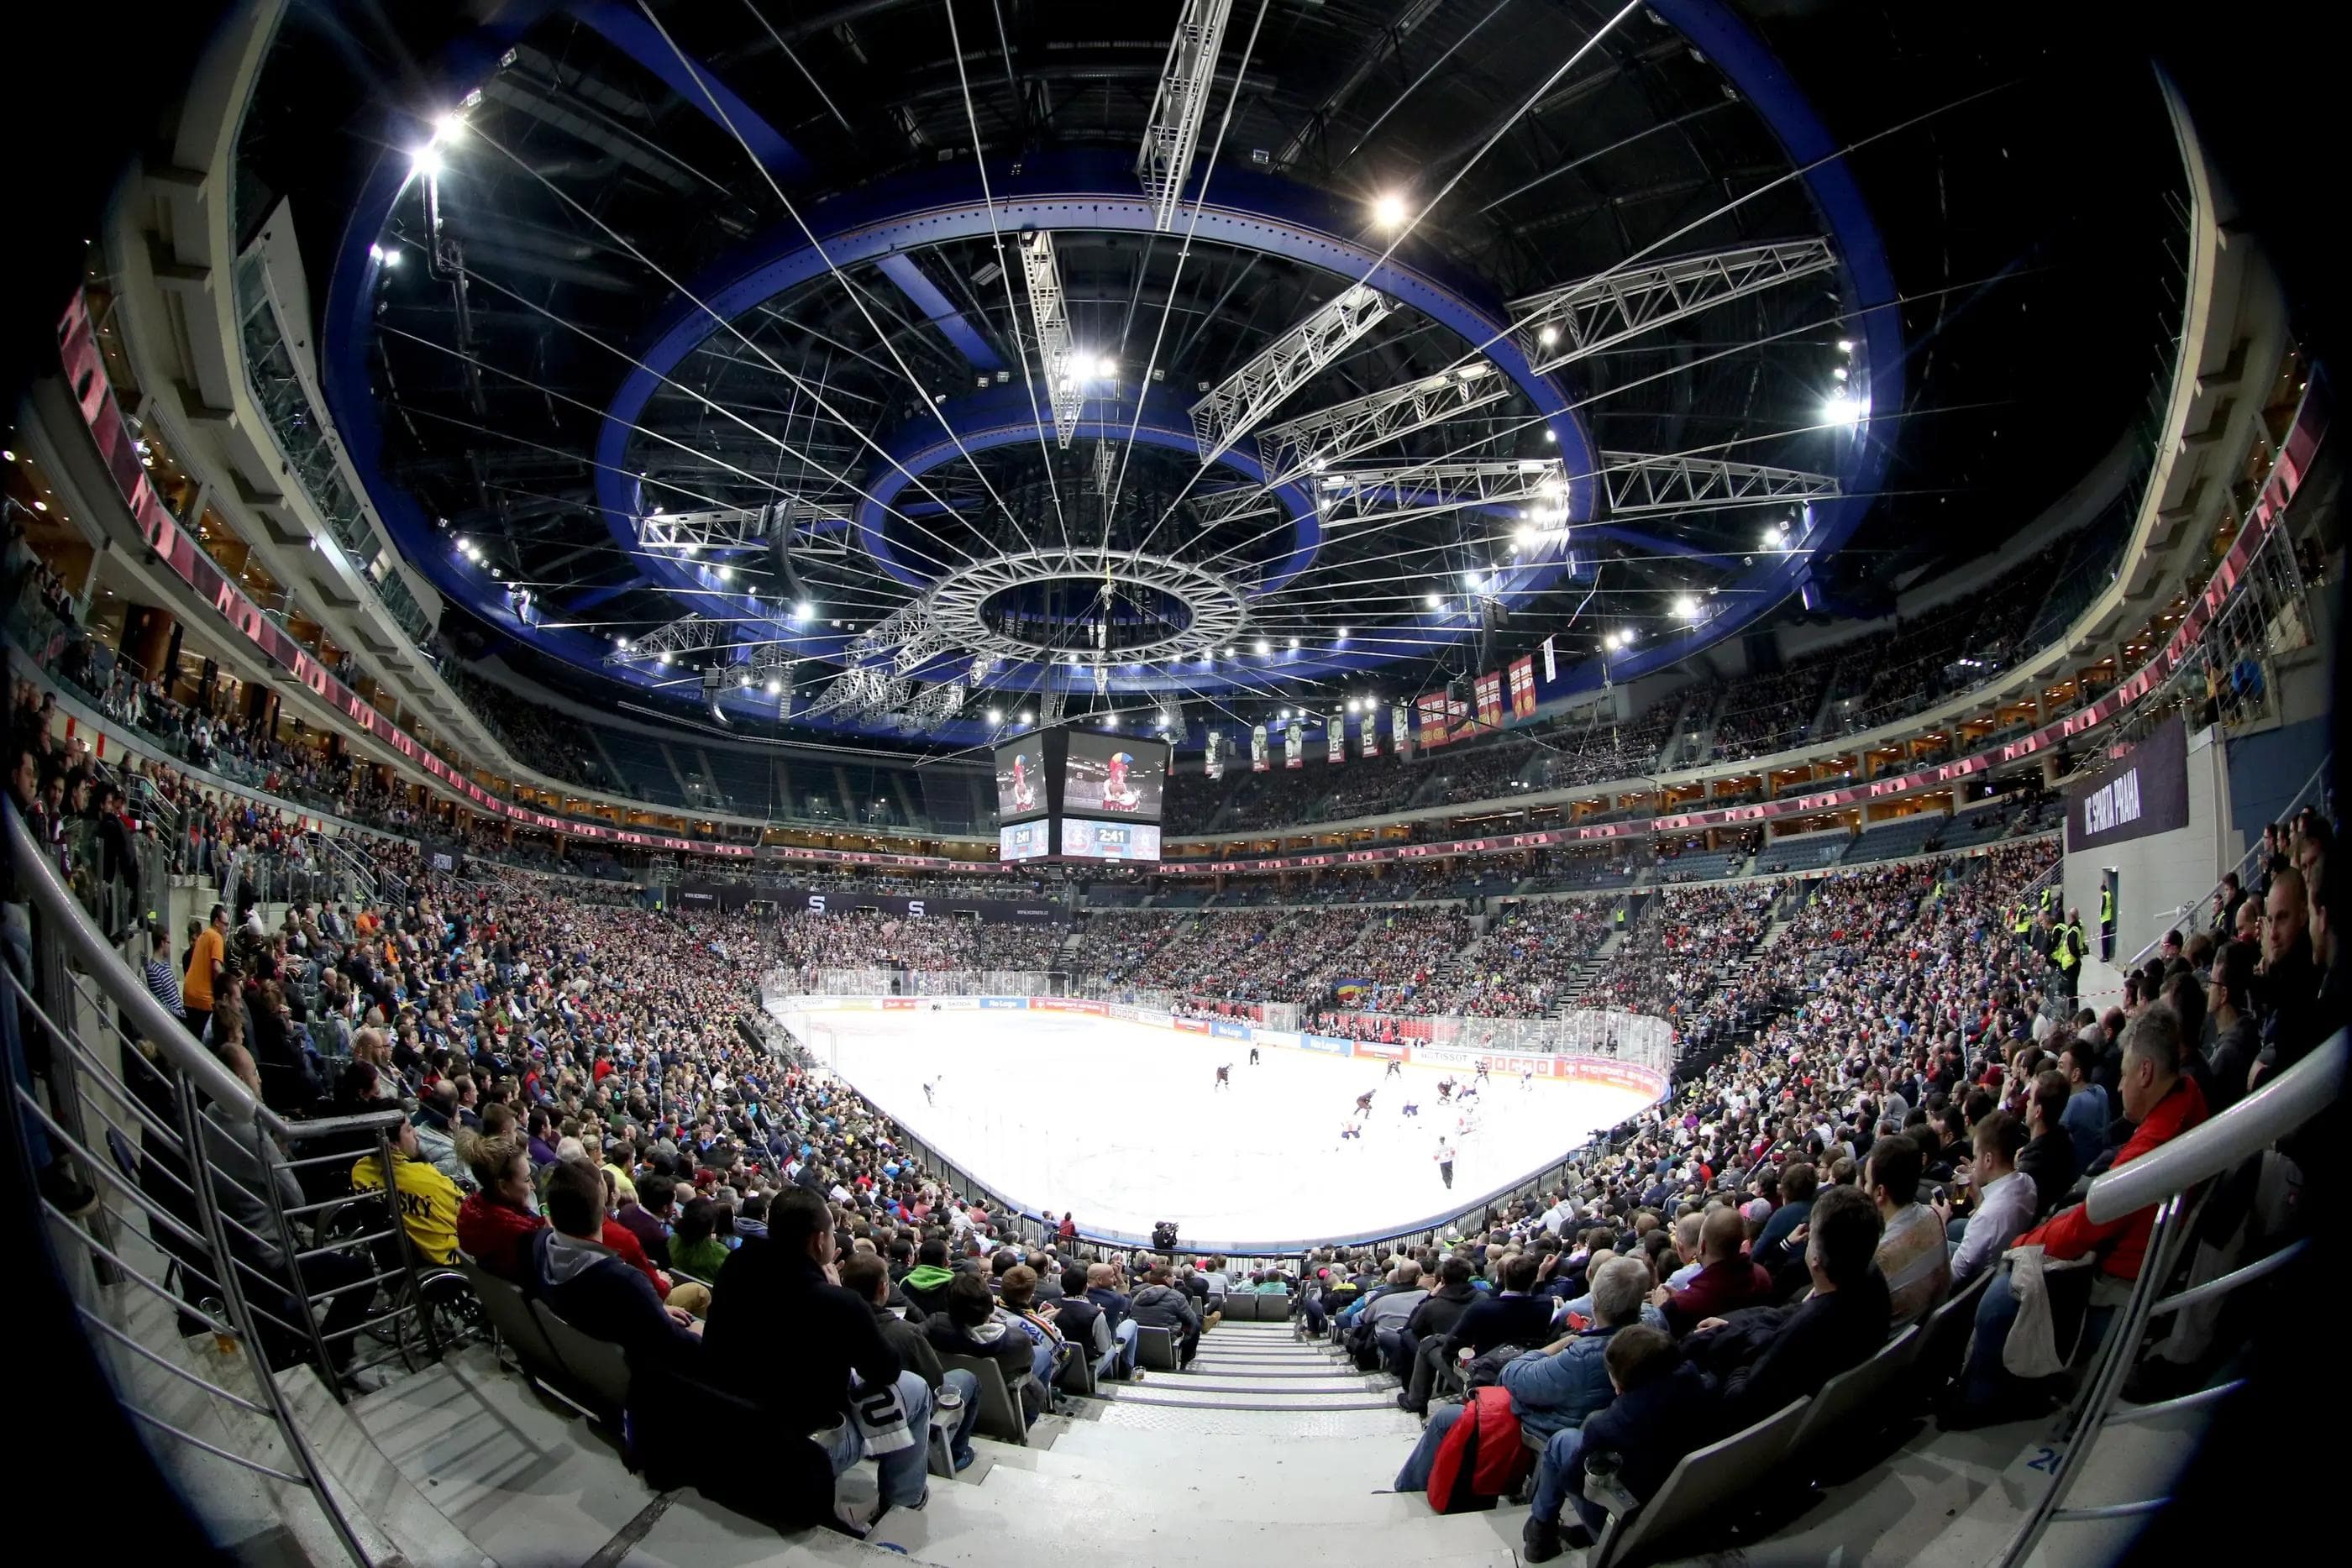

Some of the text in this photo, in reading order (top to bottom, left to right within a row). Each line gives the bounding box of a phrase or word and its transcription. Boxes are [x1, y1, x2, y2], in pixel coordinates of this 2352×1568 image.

[1329, 739, 1339, 753] 13
[1363, 733, 1373, 747] 15
[2092, 784, 2115, 833] SPARTA
[2113, 768, 2140, 826] PRAHA
[1099, 829, 1125, 843] 2:41
[808, 895, 826, 914] S
[909, 900, 925, 917] S
[1436, 1051, 1468, 1062] TISSOT
[1018, 1320, 1045, 1344] DELL
